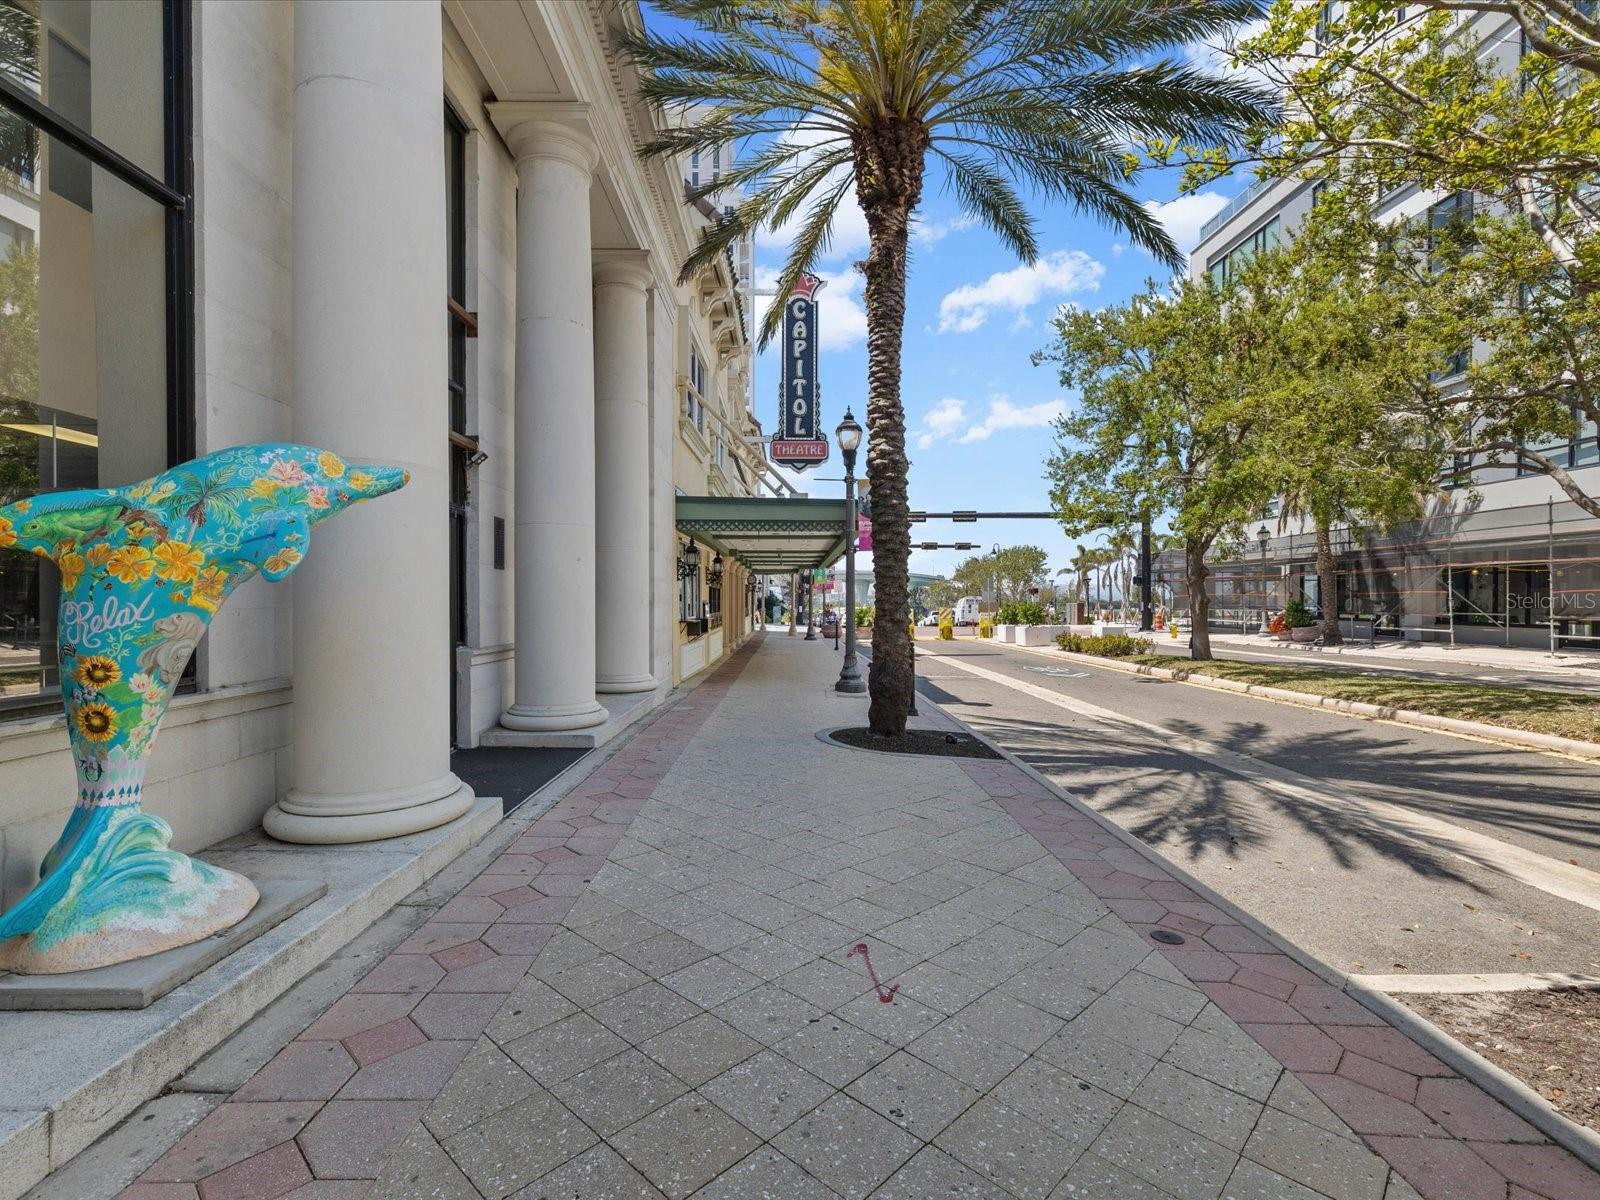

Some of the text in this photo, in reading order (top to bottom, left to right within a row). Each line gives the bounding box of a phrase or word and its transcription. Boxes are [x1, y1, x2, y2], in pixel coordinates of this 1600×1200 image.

[791, 301, 807, 435] CAPITOL
[775, 444, 824, 455] THEATRE
[63, 592, 155, 648] Relax
